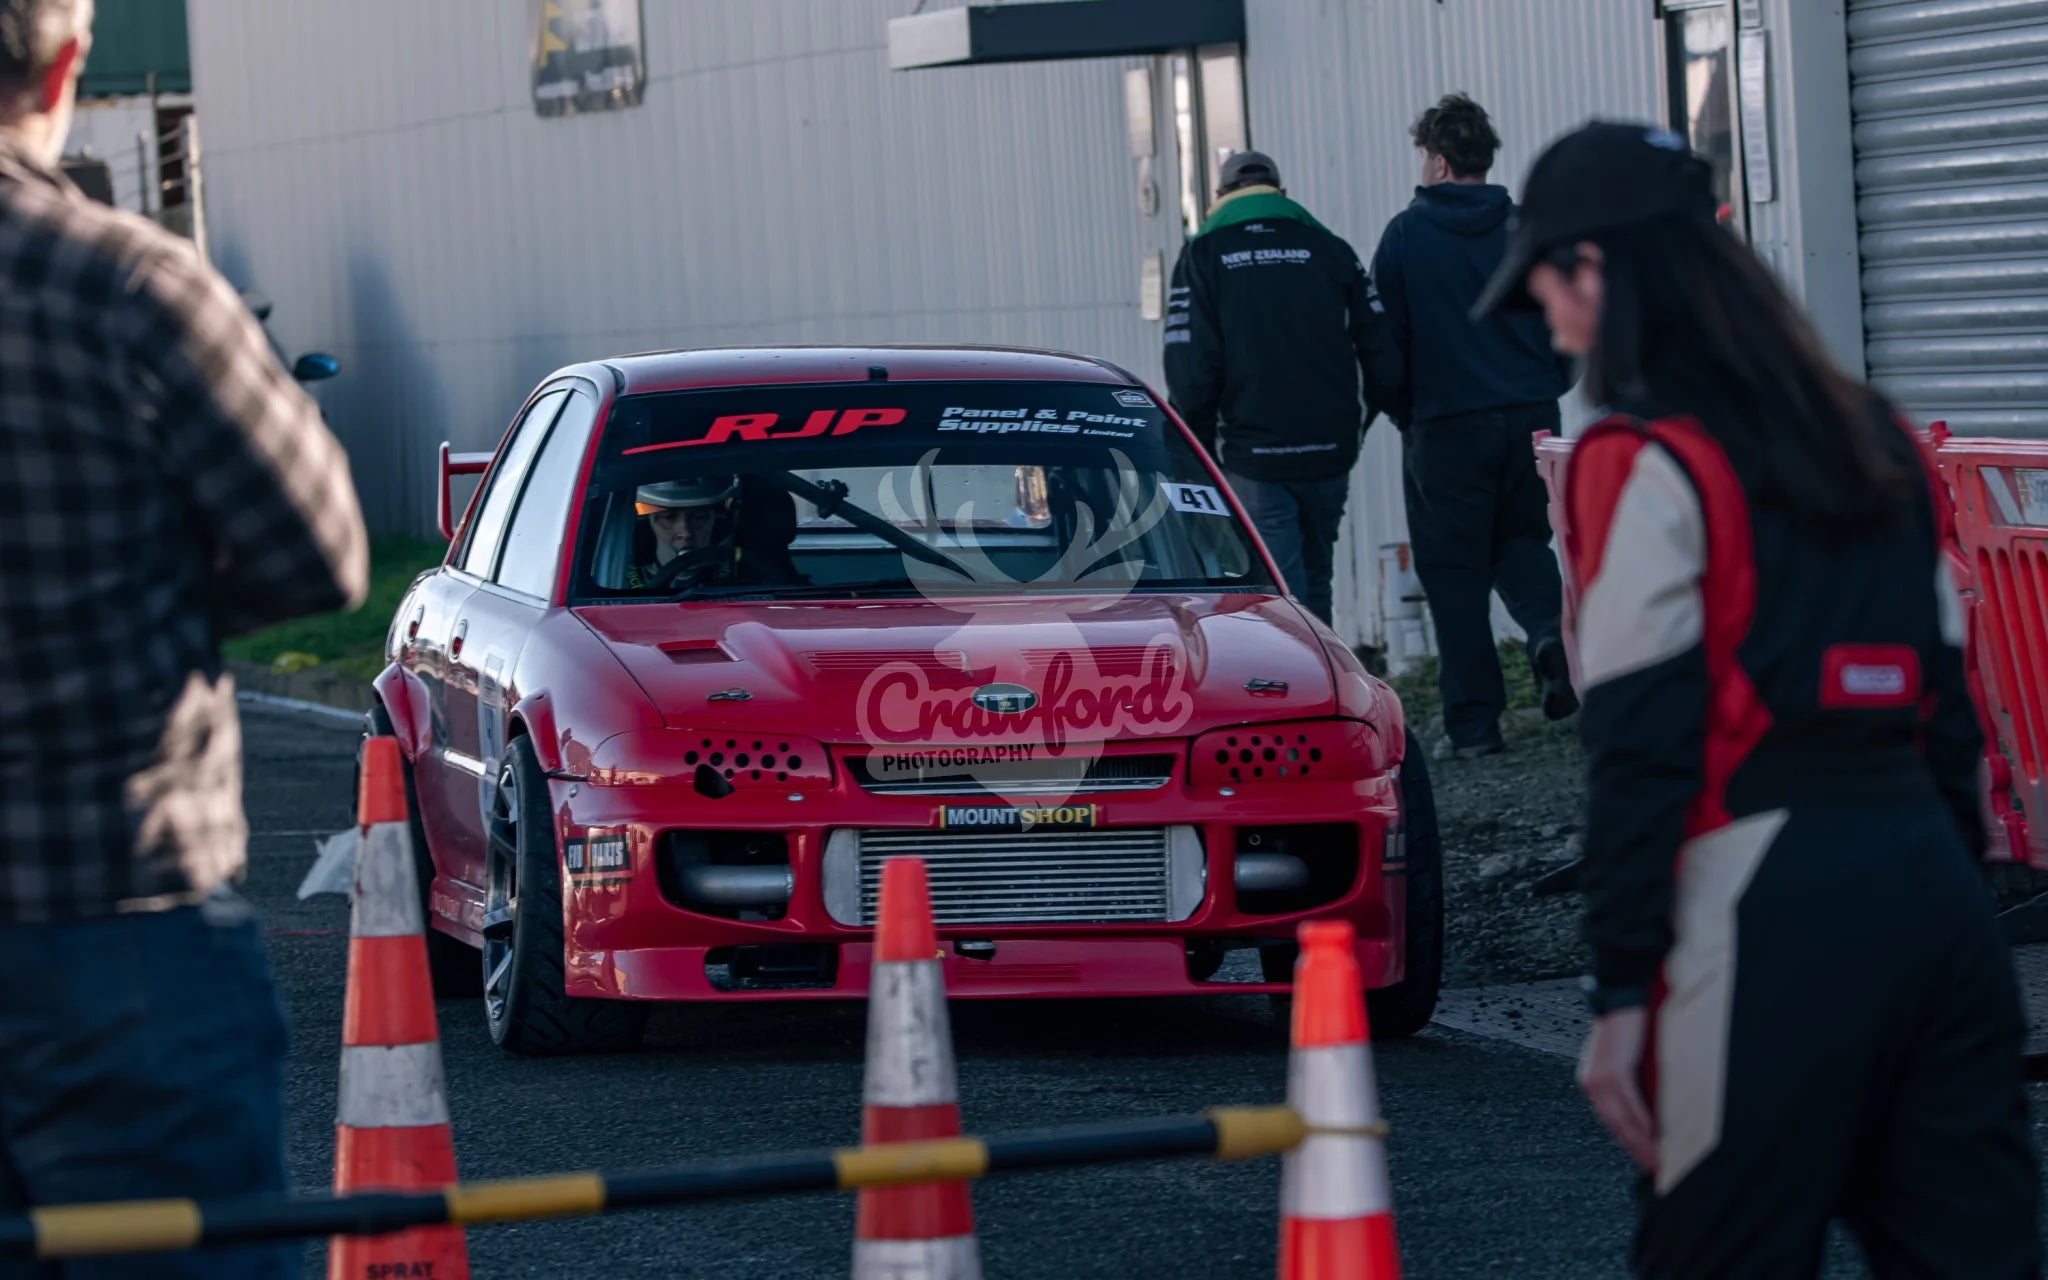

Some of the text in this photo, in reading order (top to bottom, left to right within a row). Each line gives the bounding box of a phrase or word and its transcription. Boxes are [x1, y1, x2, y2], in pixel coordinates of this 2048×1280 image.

[1221, 249, 1311, 264] NEW ZEALAND
[700, 408, 907, 441] RJP
[942, 407, 1149, 427] Panel & Paint
[937, 419, 1134, 438] Supplies Limited
[1180, 488, 1217, 511] 41
[366, 1261, 435, 1280] SPRAY
